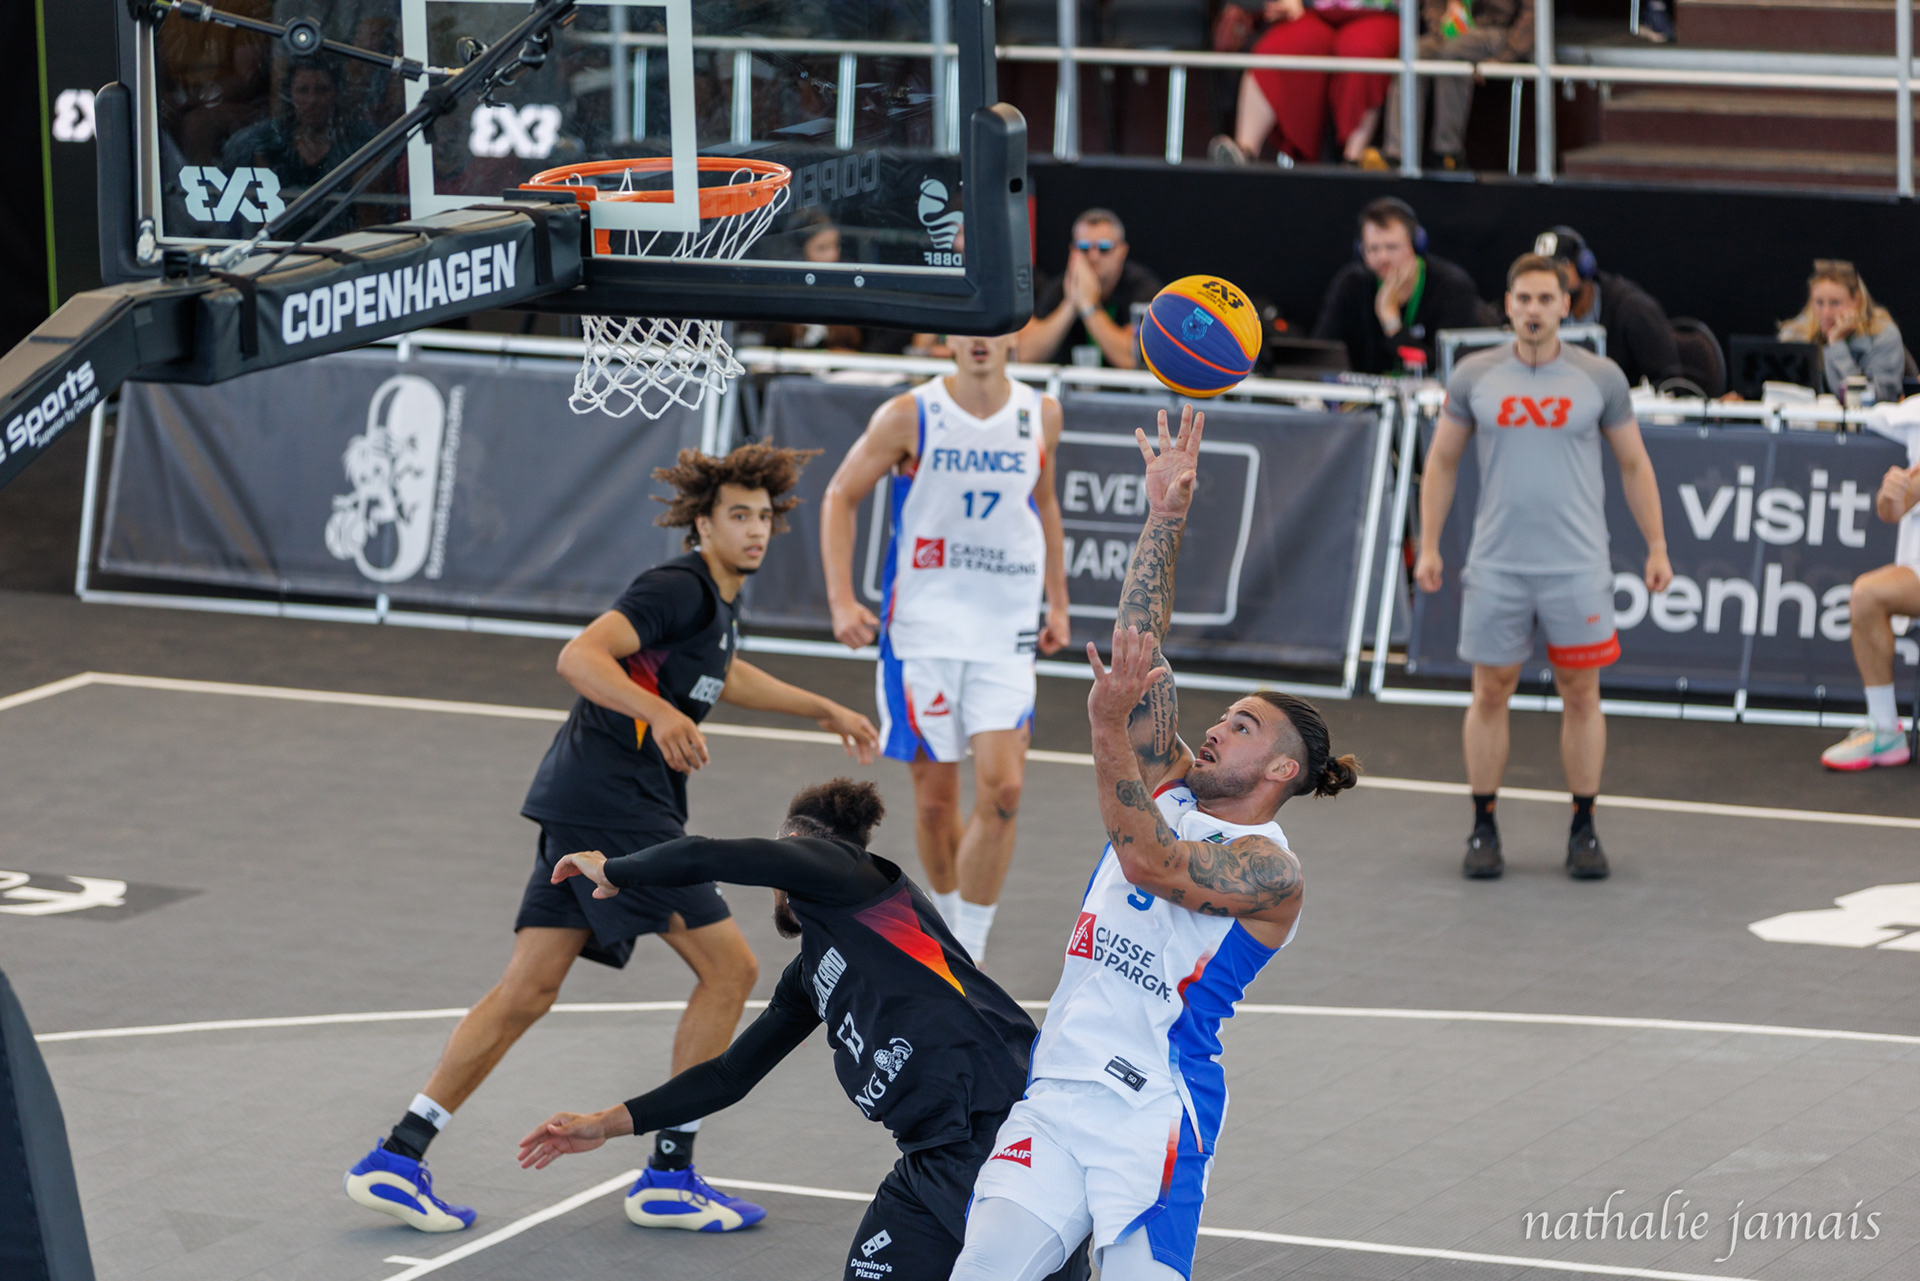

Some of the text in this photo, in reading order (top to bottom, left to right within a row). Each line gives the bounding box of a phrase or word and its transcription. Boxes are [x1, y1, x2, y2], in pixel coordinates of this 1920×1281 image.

[281, 240, 517, 345] COPENHAGEN
[6, 360, 96, 454] Sports
[932, 448, 1027, 473] FRANCE
[962, 490, 1001, 519] 17
[1678, 464, 1872, 548] visit
[997, 1148, 1032, 1159] MAIF
[850, 1258, 893, 1273] Domino's
[855, 1268, 880, 1280] Pizza
